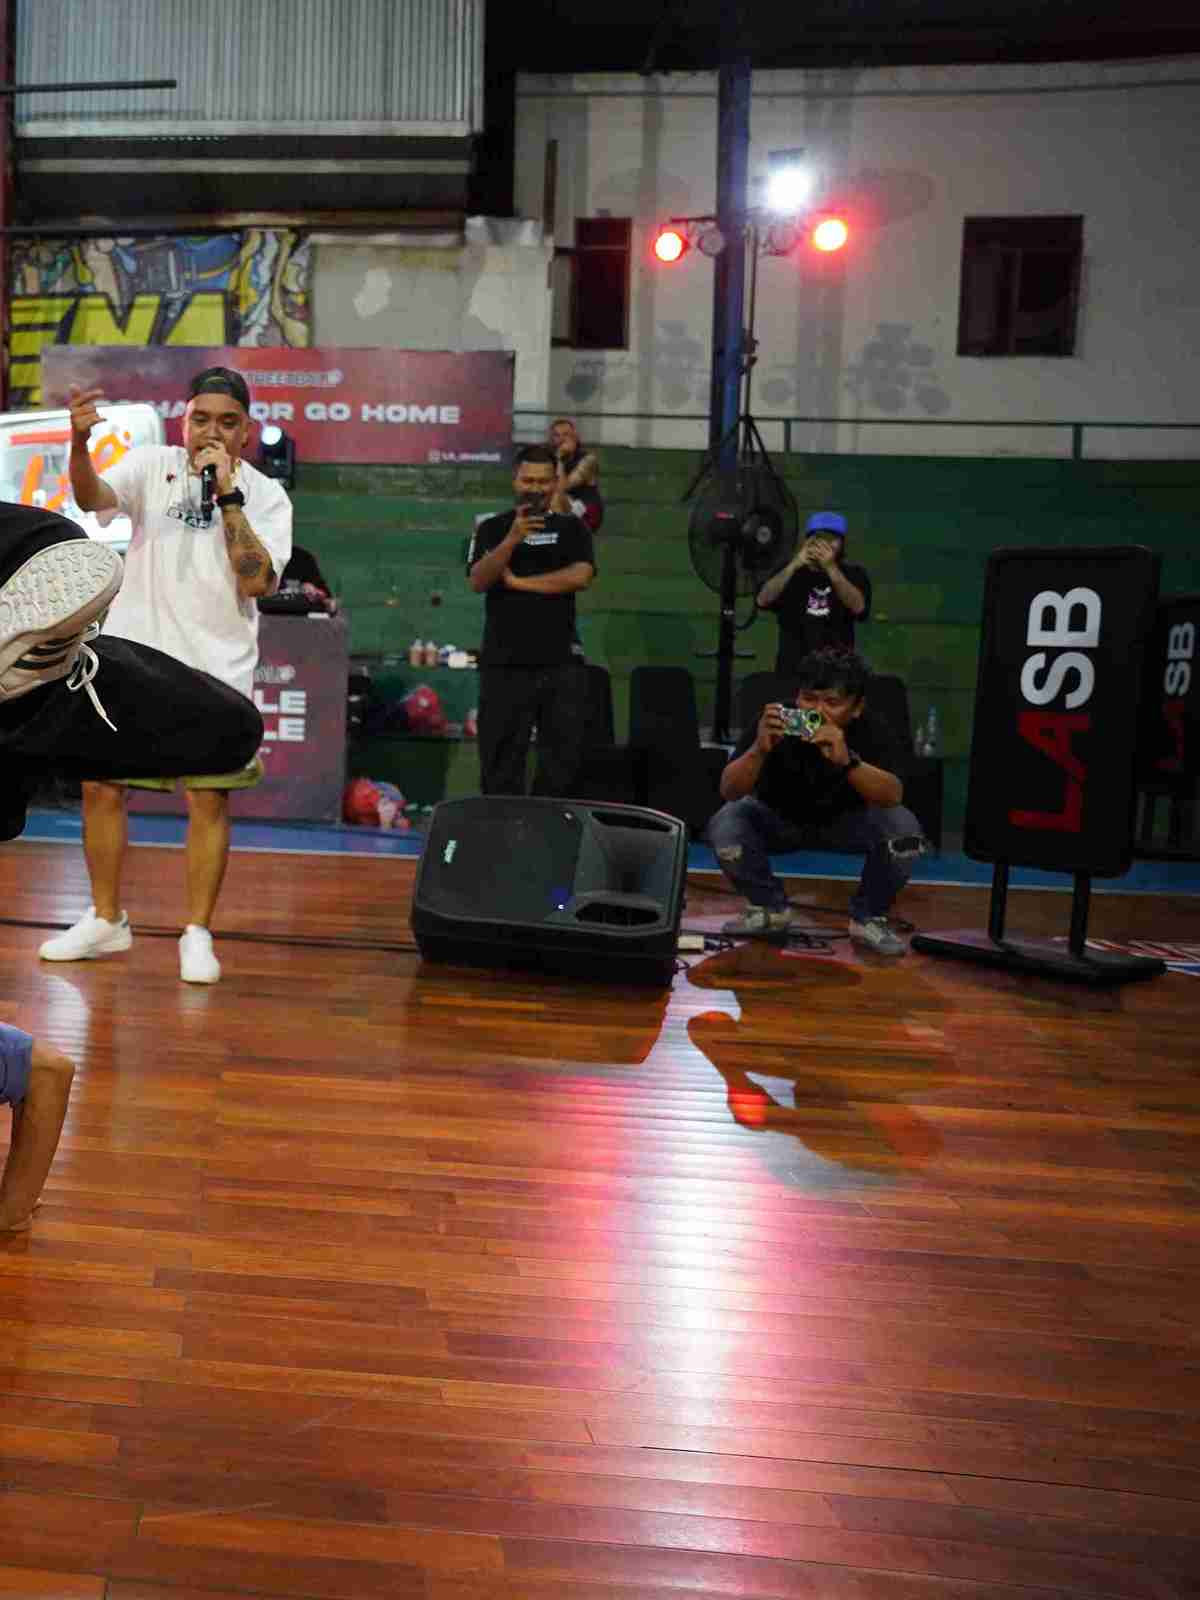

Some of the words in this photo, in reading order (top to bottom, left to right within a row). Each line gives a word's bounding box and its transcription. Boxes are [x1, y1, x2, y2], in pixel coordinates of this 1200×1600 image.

[249, 402, 294, 421] OR
[304, 402, 351, 421] GO
[361, 404, 461, 425] HOME
[1007, 586, 1102, 833] LASB
